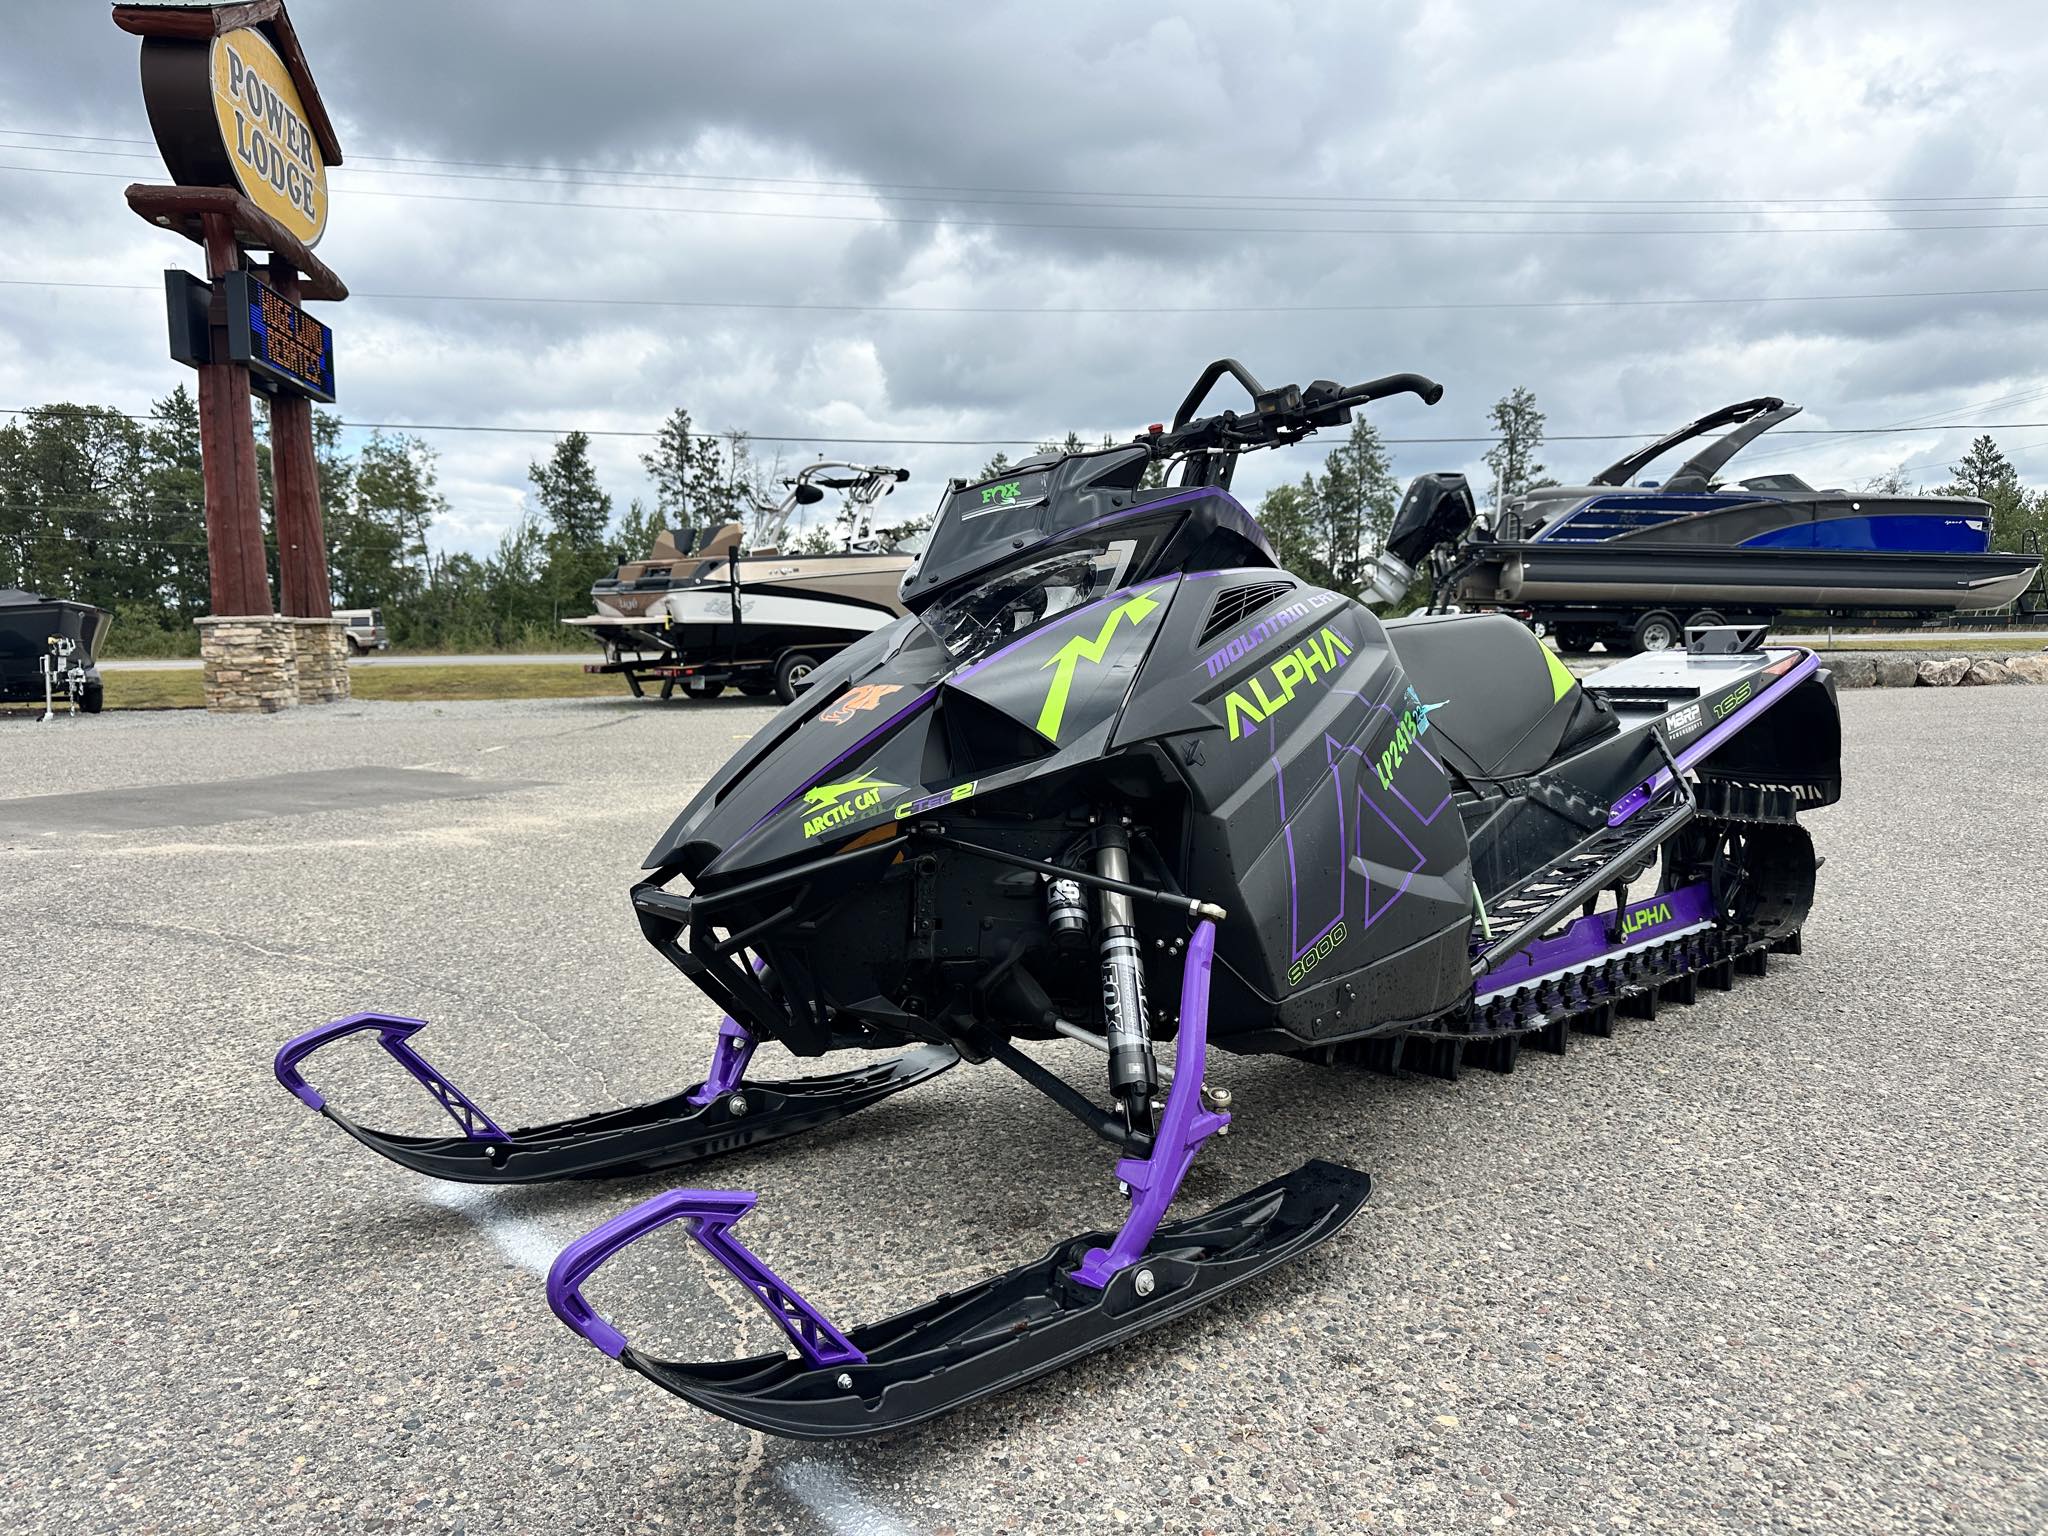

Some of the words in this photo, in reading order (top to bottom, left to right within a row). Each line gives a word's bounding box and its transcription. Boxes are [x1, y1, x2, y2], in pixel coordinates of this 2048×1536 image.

[226, 45, 316, 173] POWER
[235, 110, 316, 223] LODGE
[261, 288, 293, 338] HUGE
[982, 482, 1021, 506] FOX
[1205, 602, 1310, 679] MOUNTAIN
[1307, 590, 1339, 609] CAT
[1225, 627, 1352, 741] ALPHA
[1713, 681, 1752, 720] 165
[1665, 703, 1701, 732] MBRP
[803, 800, 856, 839] ARCTIC
[855, 787, 881, 811] CAT
[1287, 921, 1347, 986] 8000
[1101, 963, 1126, 1035] FOX
